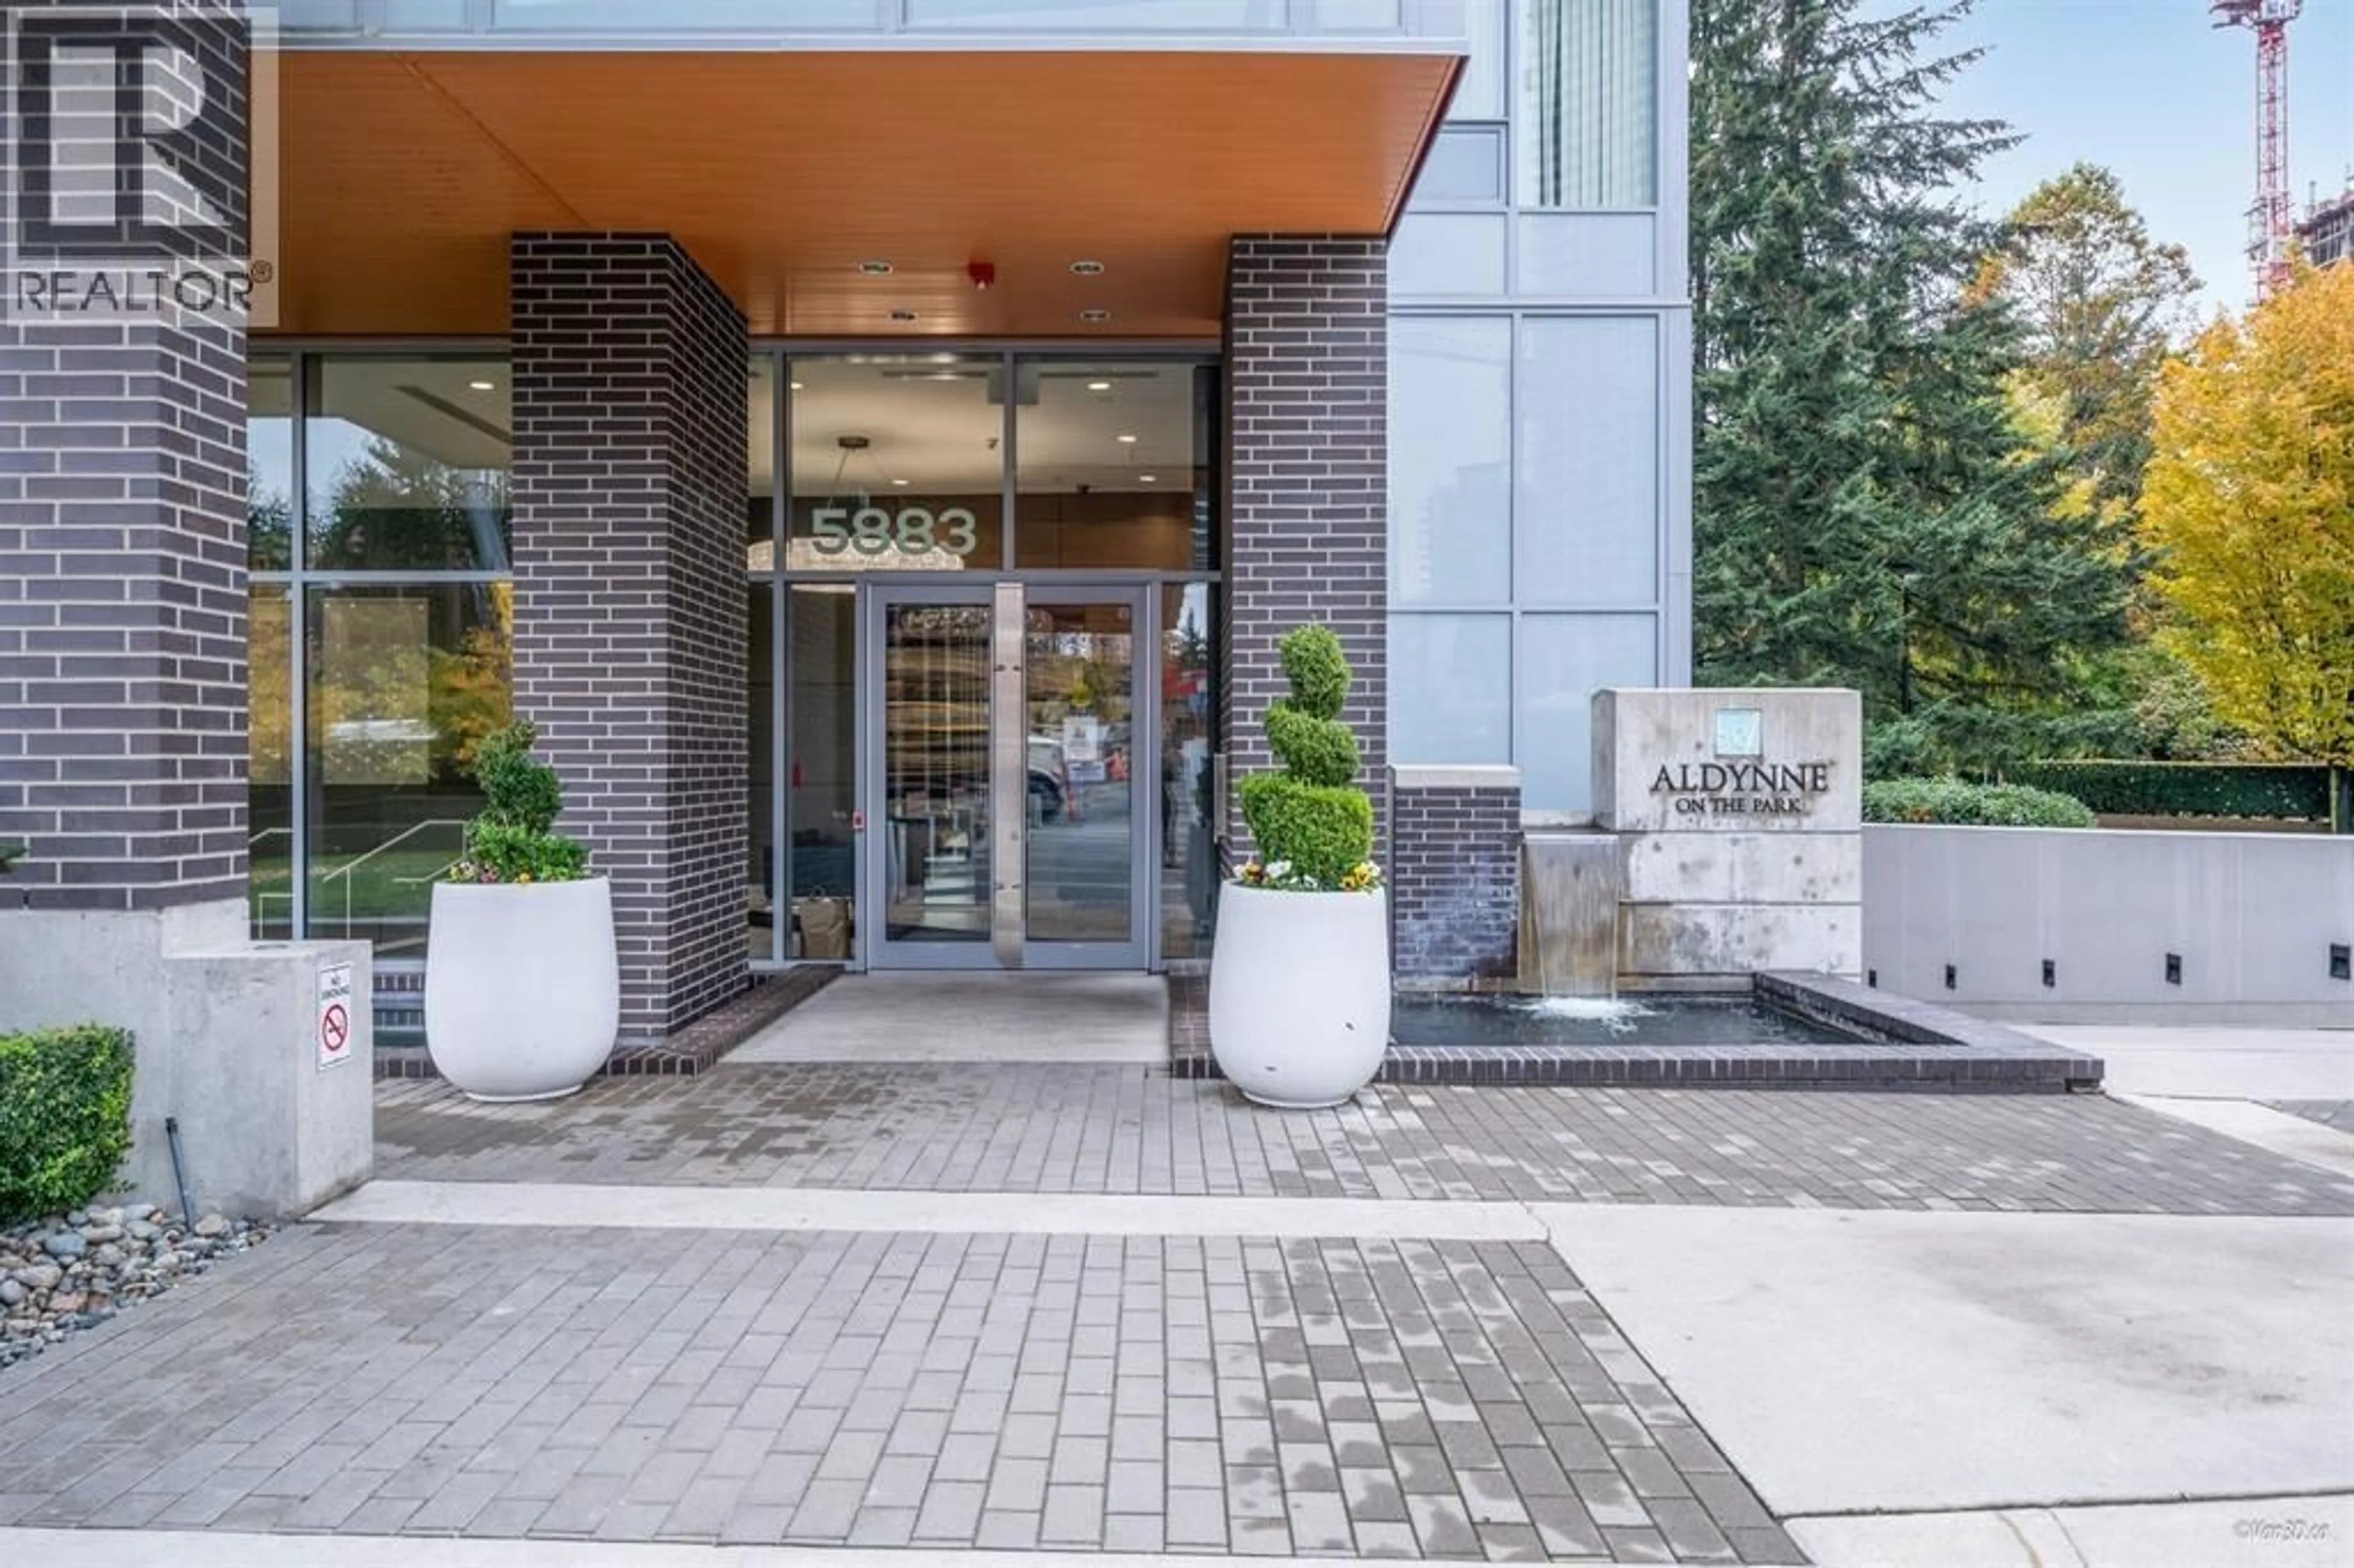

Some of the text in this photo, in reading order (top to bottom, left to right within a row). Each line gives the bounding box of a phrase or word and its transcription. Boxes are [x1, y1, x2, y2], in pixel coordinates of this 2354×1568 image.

[812, 508, 976, 554] 5883
[1650, 763, 1829, 793] ALDYNNE
[1675, 797, 1802, 814] ON THE PARK
